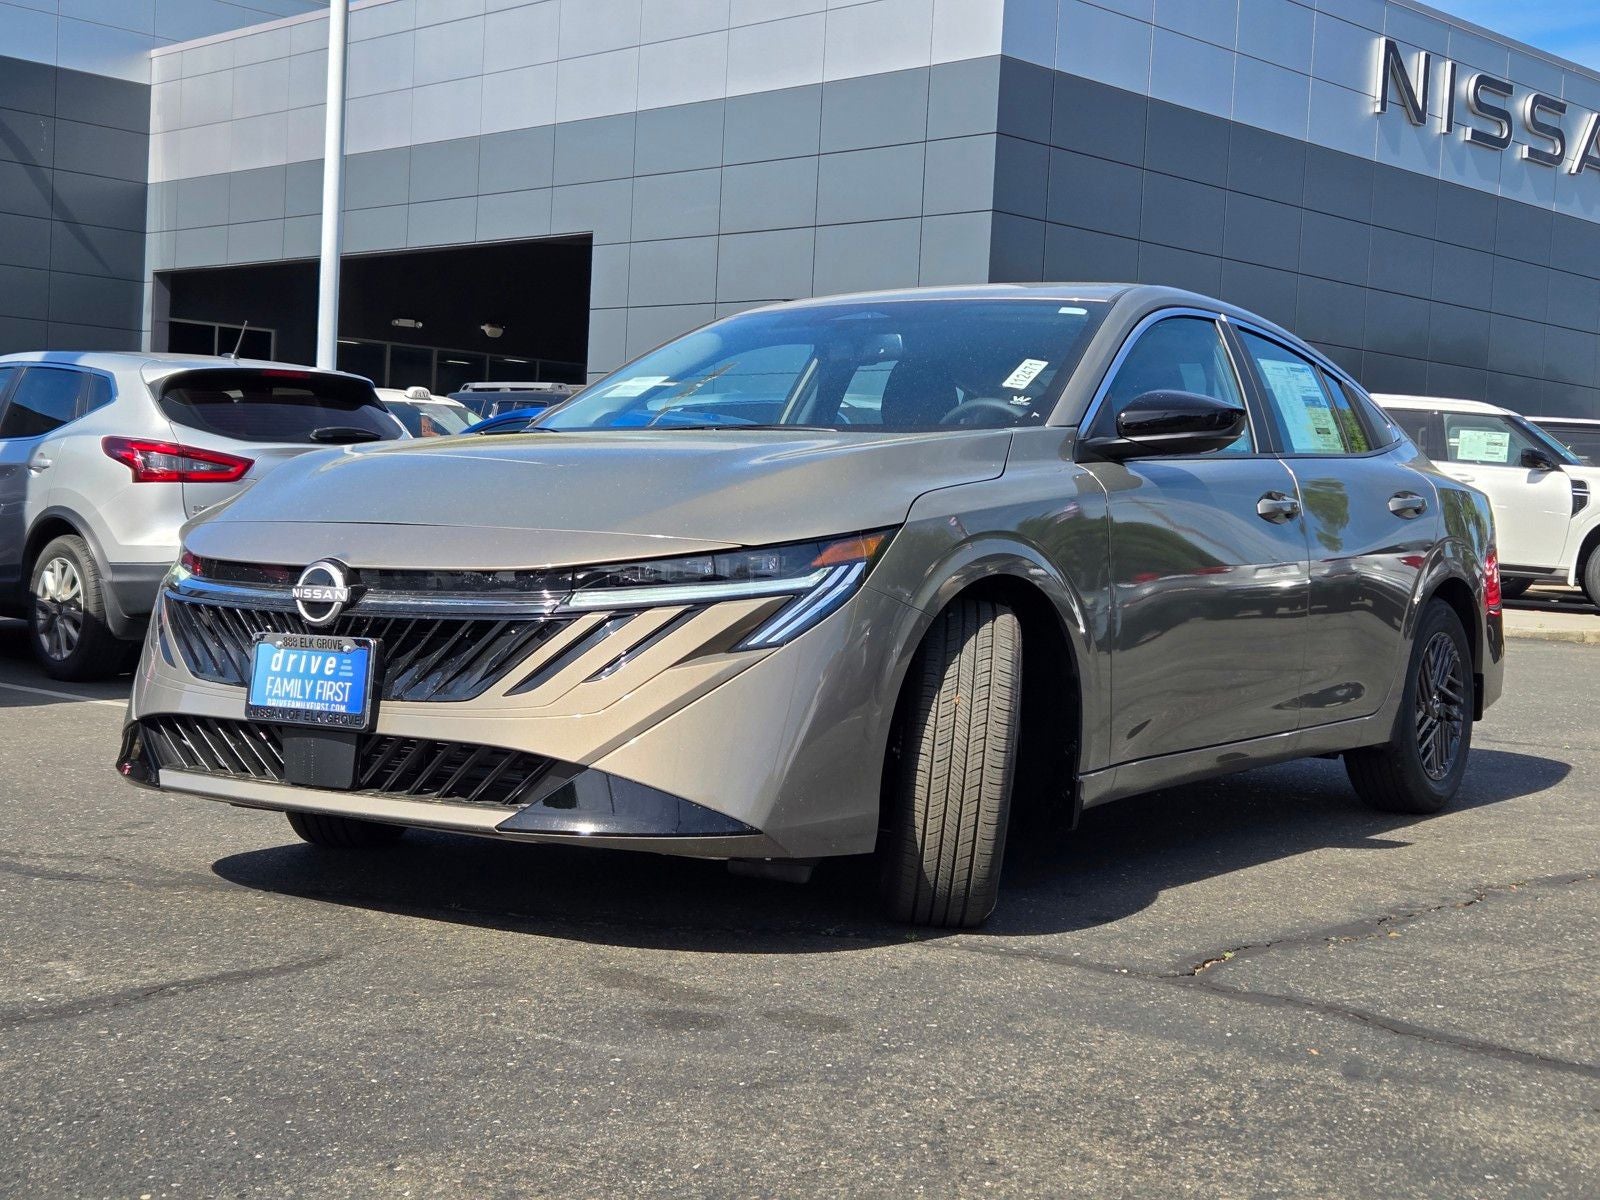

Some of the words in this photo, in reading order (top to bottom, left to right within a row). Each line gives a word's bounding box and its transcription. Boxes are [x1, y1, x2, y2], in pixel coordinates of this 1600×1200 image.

[292, 588, 346, 599] NISSAN
[299, 637, 315, 648] ELK
[316, 638, 343, 650] GROVE
[271, 649, 337, 675] drive
[265, 677, 314, 699] FAMILY
[315, 680, 352, 703] FIRST
[303, 710, 325, 723] ELK
